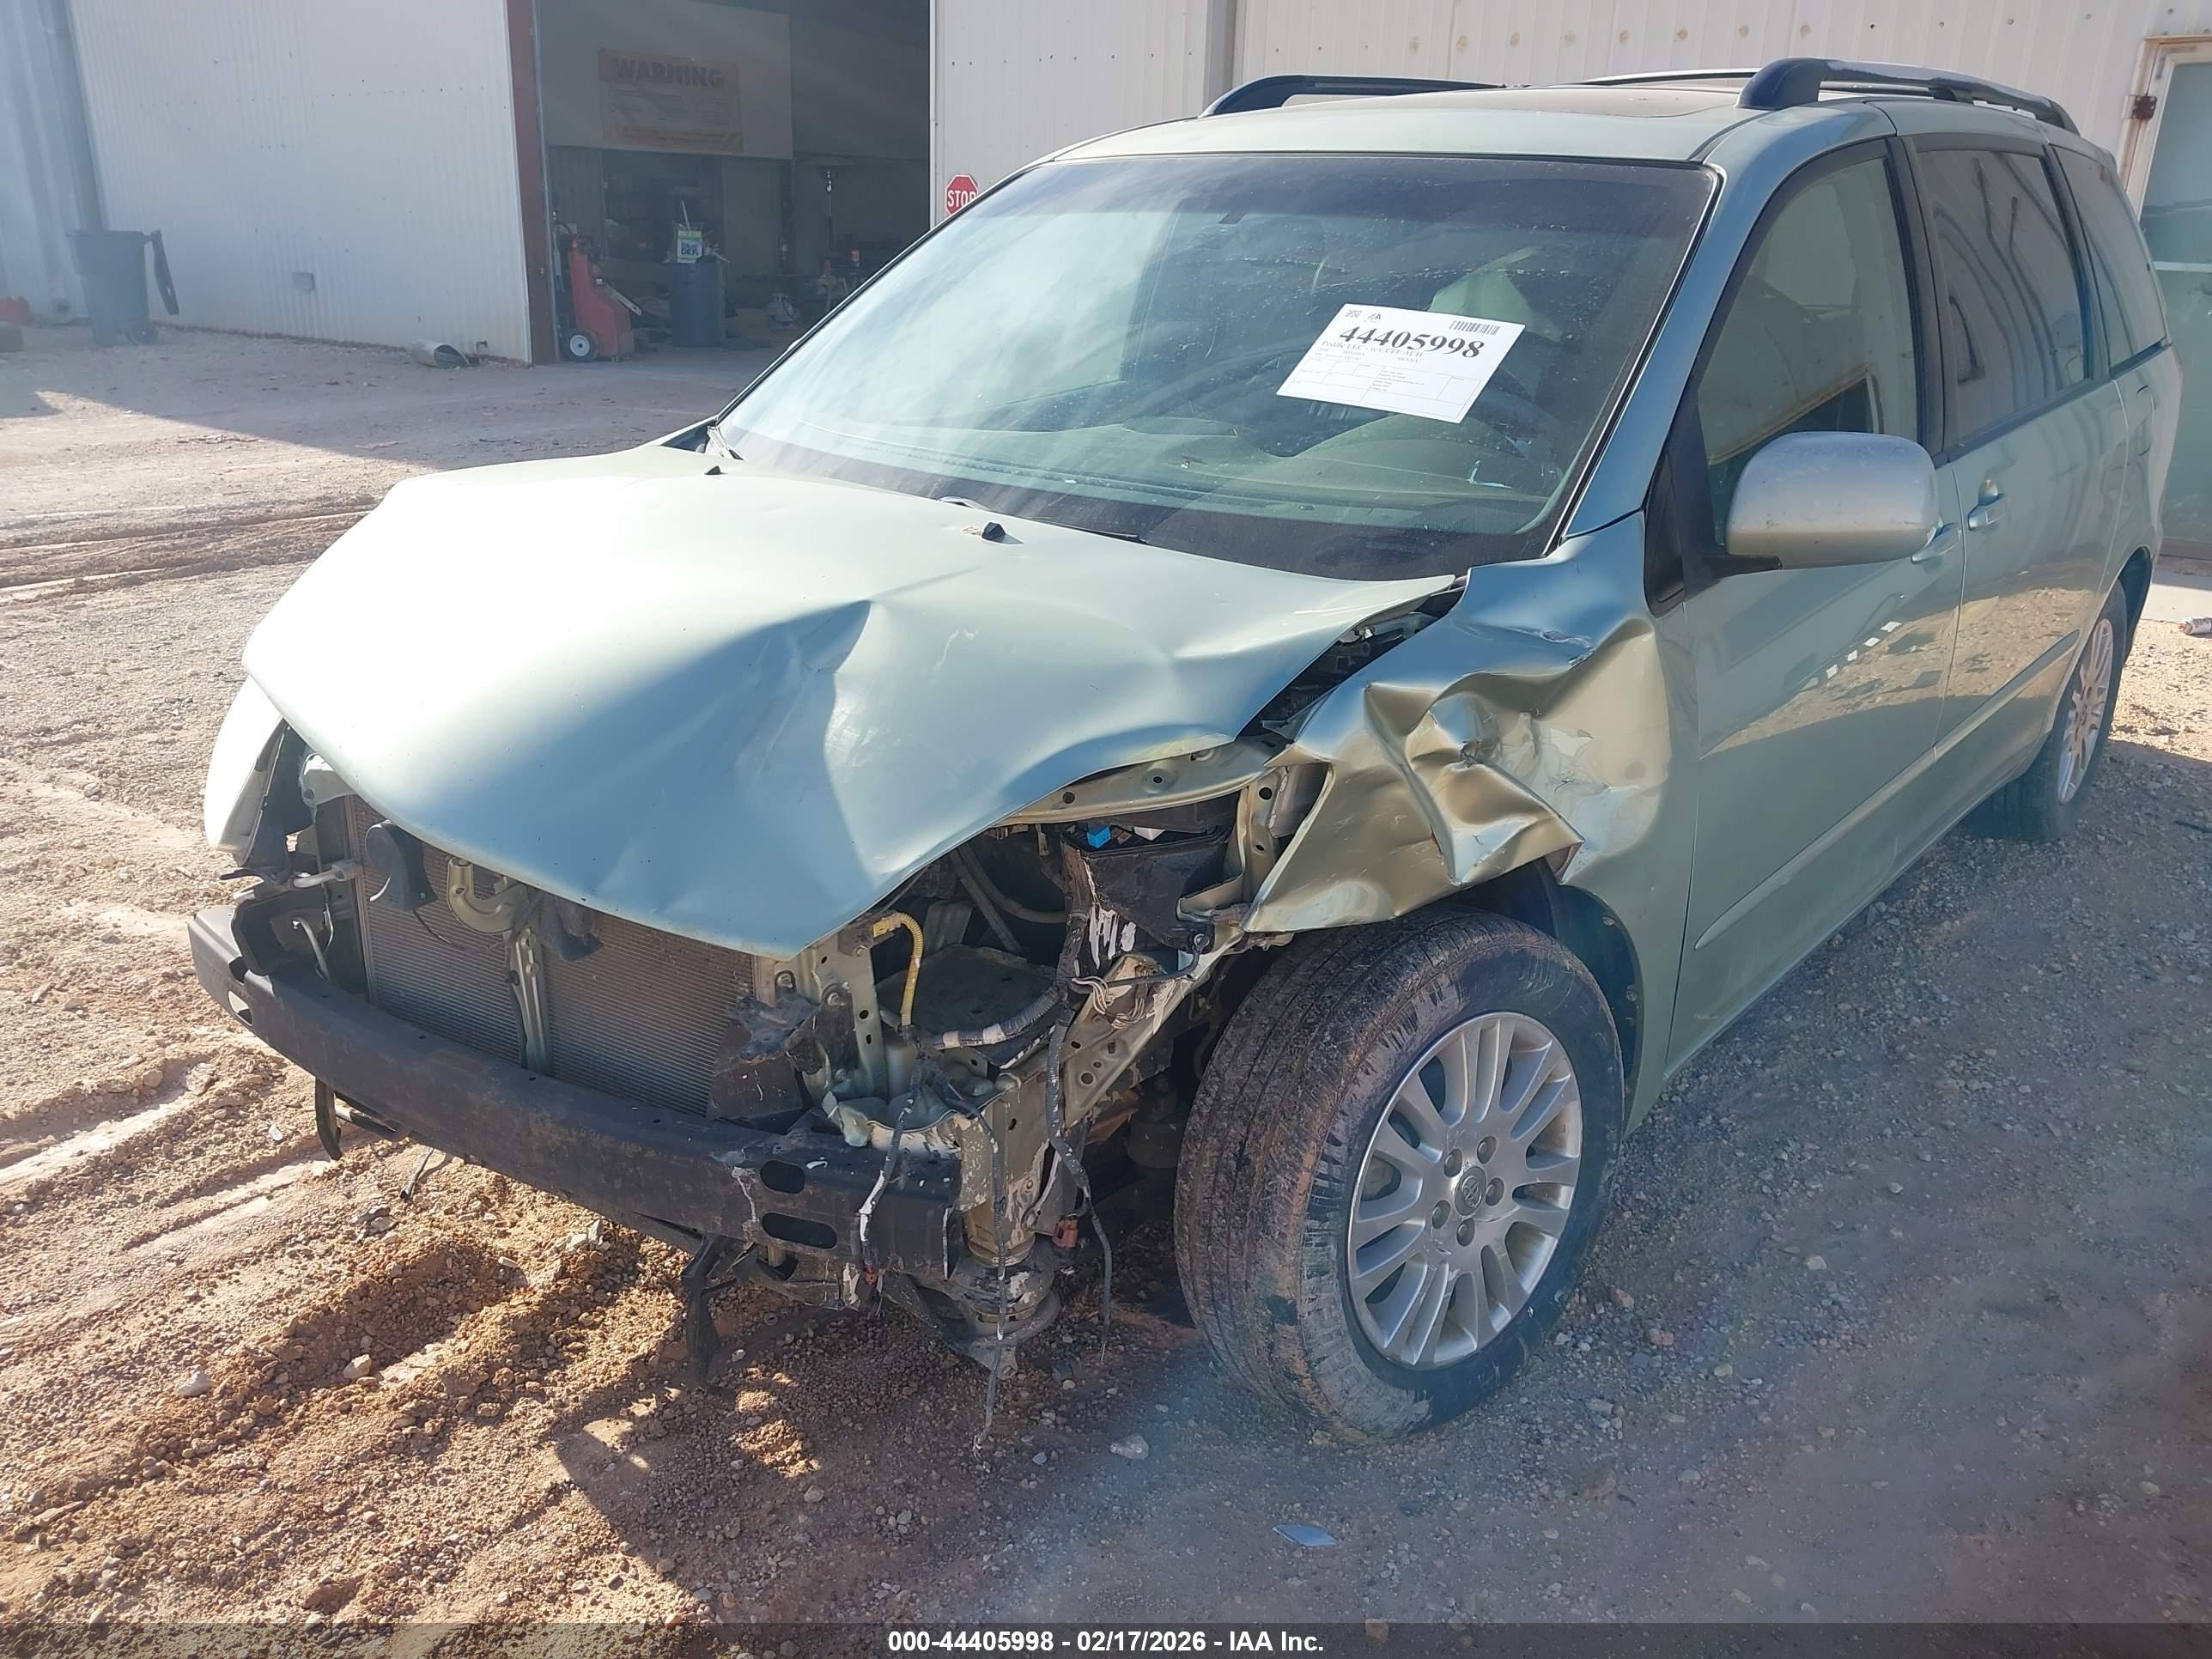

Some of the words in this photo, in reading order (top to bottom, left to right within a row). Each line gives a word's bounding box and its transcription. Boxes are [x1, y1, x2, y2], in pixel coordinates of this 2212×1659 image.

[613, 57, 725, 88] WARNING
[948, 190, 976, 207] STOP
[1340, 325, 1485, 358] 44405998
